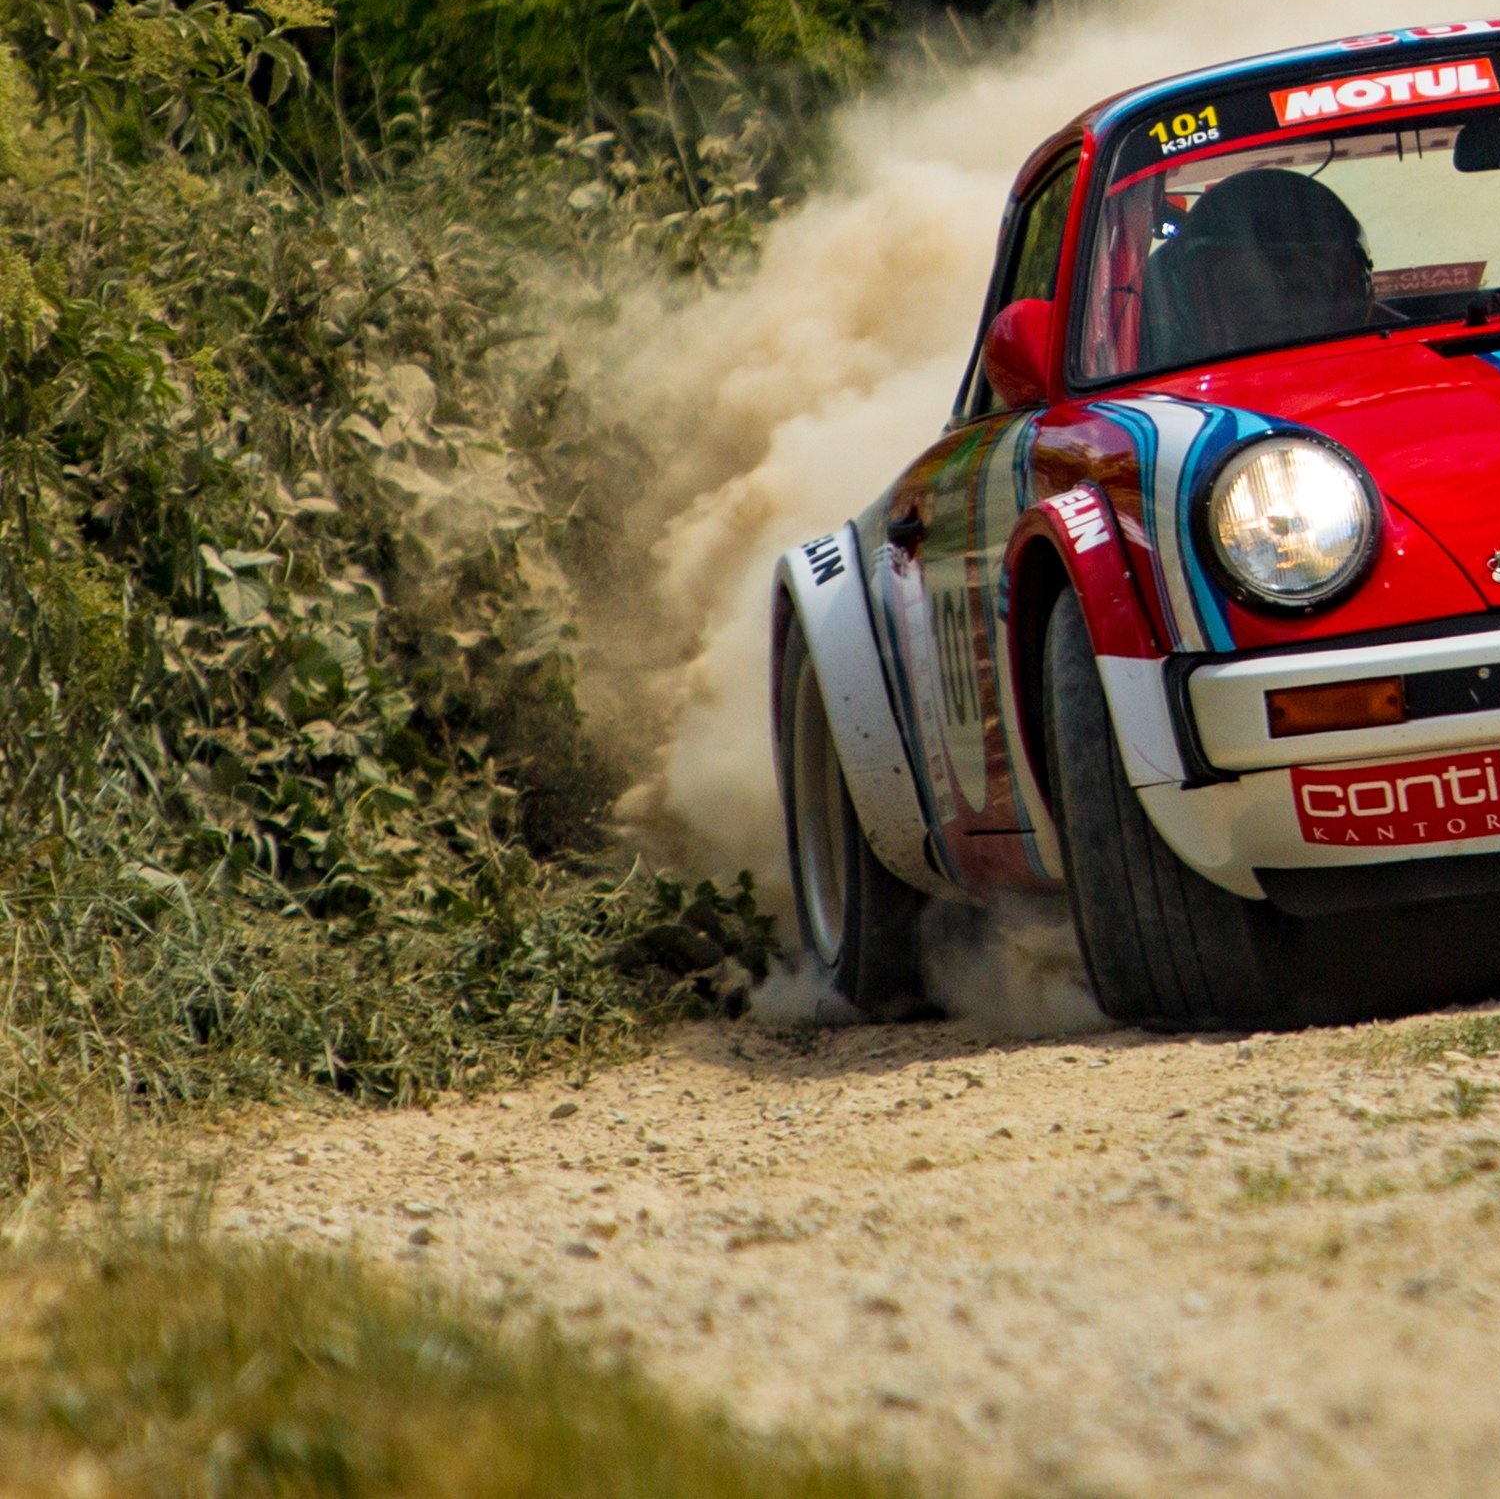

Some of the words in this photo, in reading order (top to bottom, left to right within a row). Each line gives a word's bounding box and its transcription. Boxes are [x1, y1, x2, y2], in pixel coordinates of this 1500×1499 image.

[1284, 64, 1490, 121] MOTUL
[1149, 105, 1218, 143] 101
[1161, 128, 1220, 155] K3/D5
[1301, 757, 1499, 818] conti
